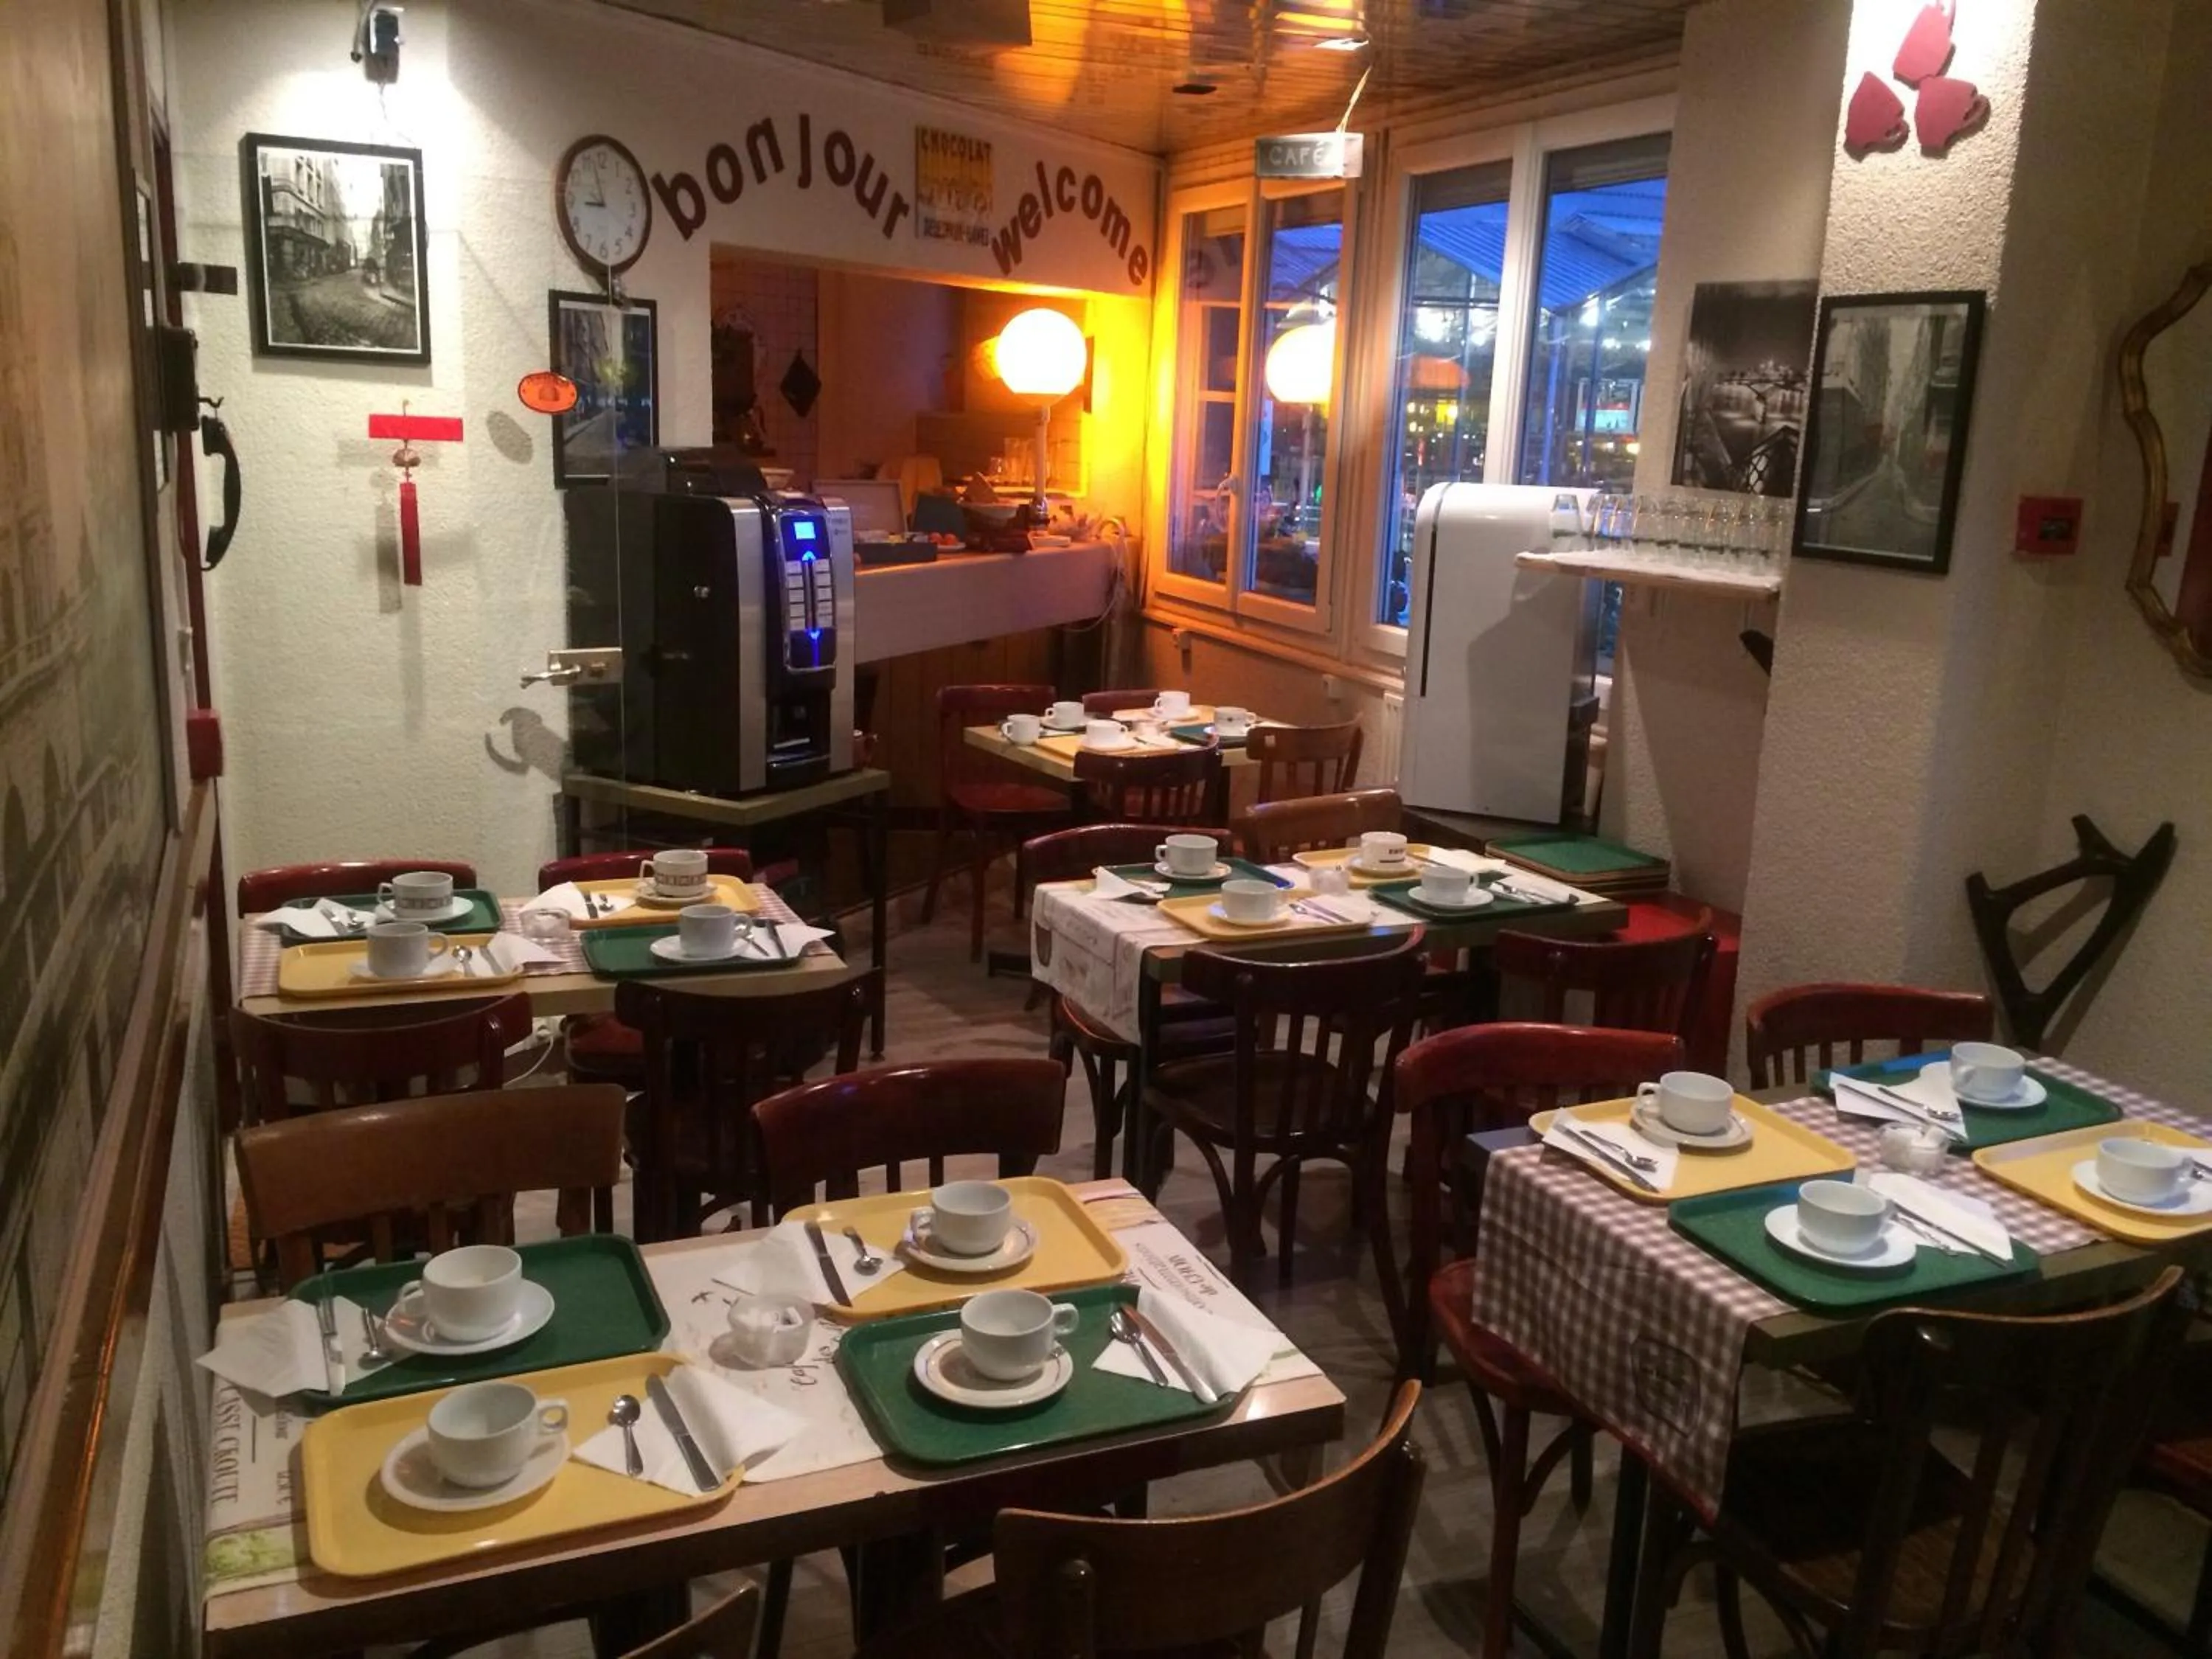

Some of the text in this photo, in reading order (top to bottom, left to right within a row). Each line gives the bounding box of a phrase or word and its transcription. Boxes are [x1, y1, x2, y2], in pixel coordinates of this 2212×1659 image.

[597, 151, 608, 169] 12
[919, 127, 992, 164] CHOCOLAT
[1269, 142, 1326, 166] CAFÉ
[991, 160, 1149, 287] welcome
